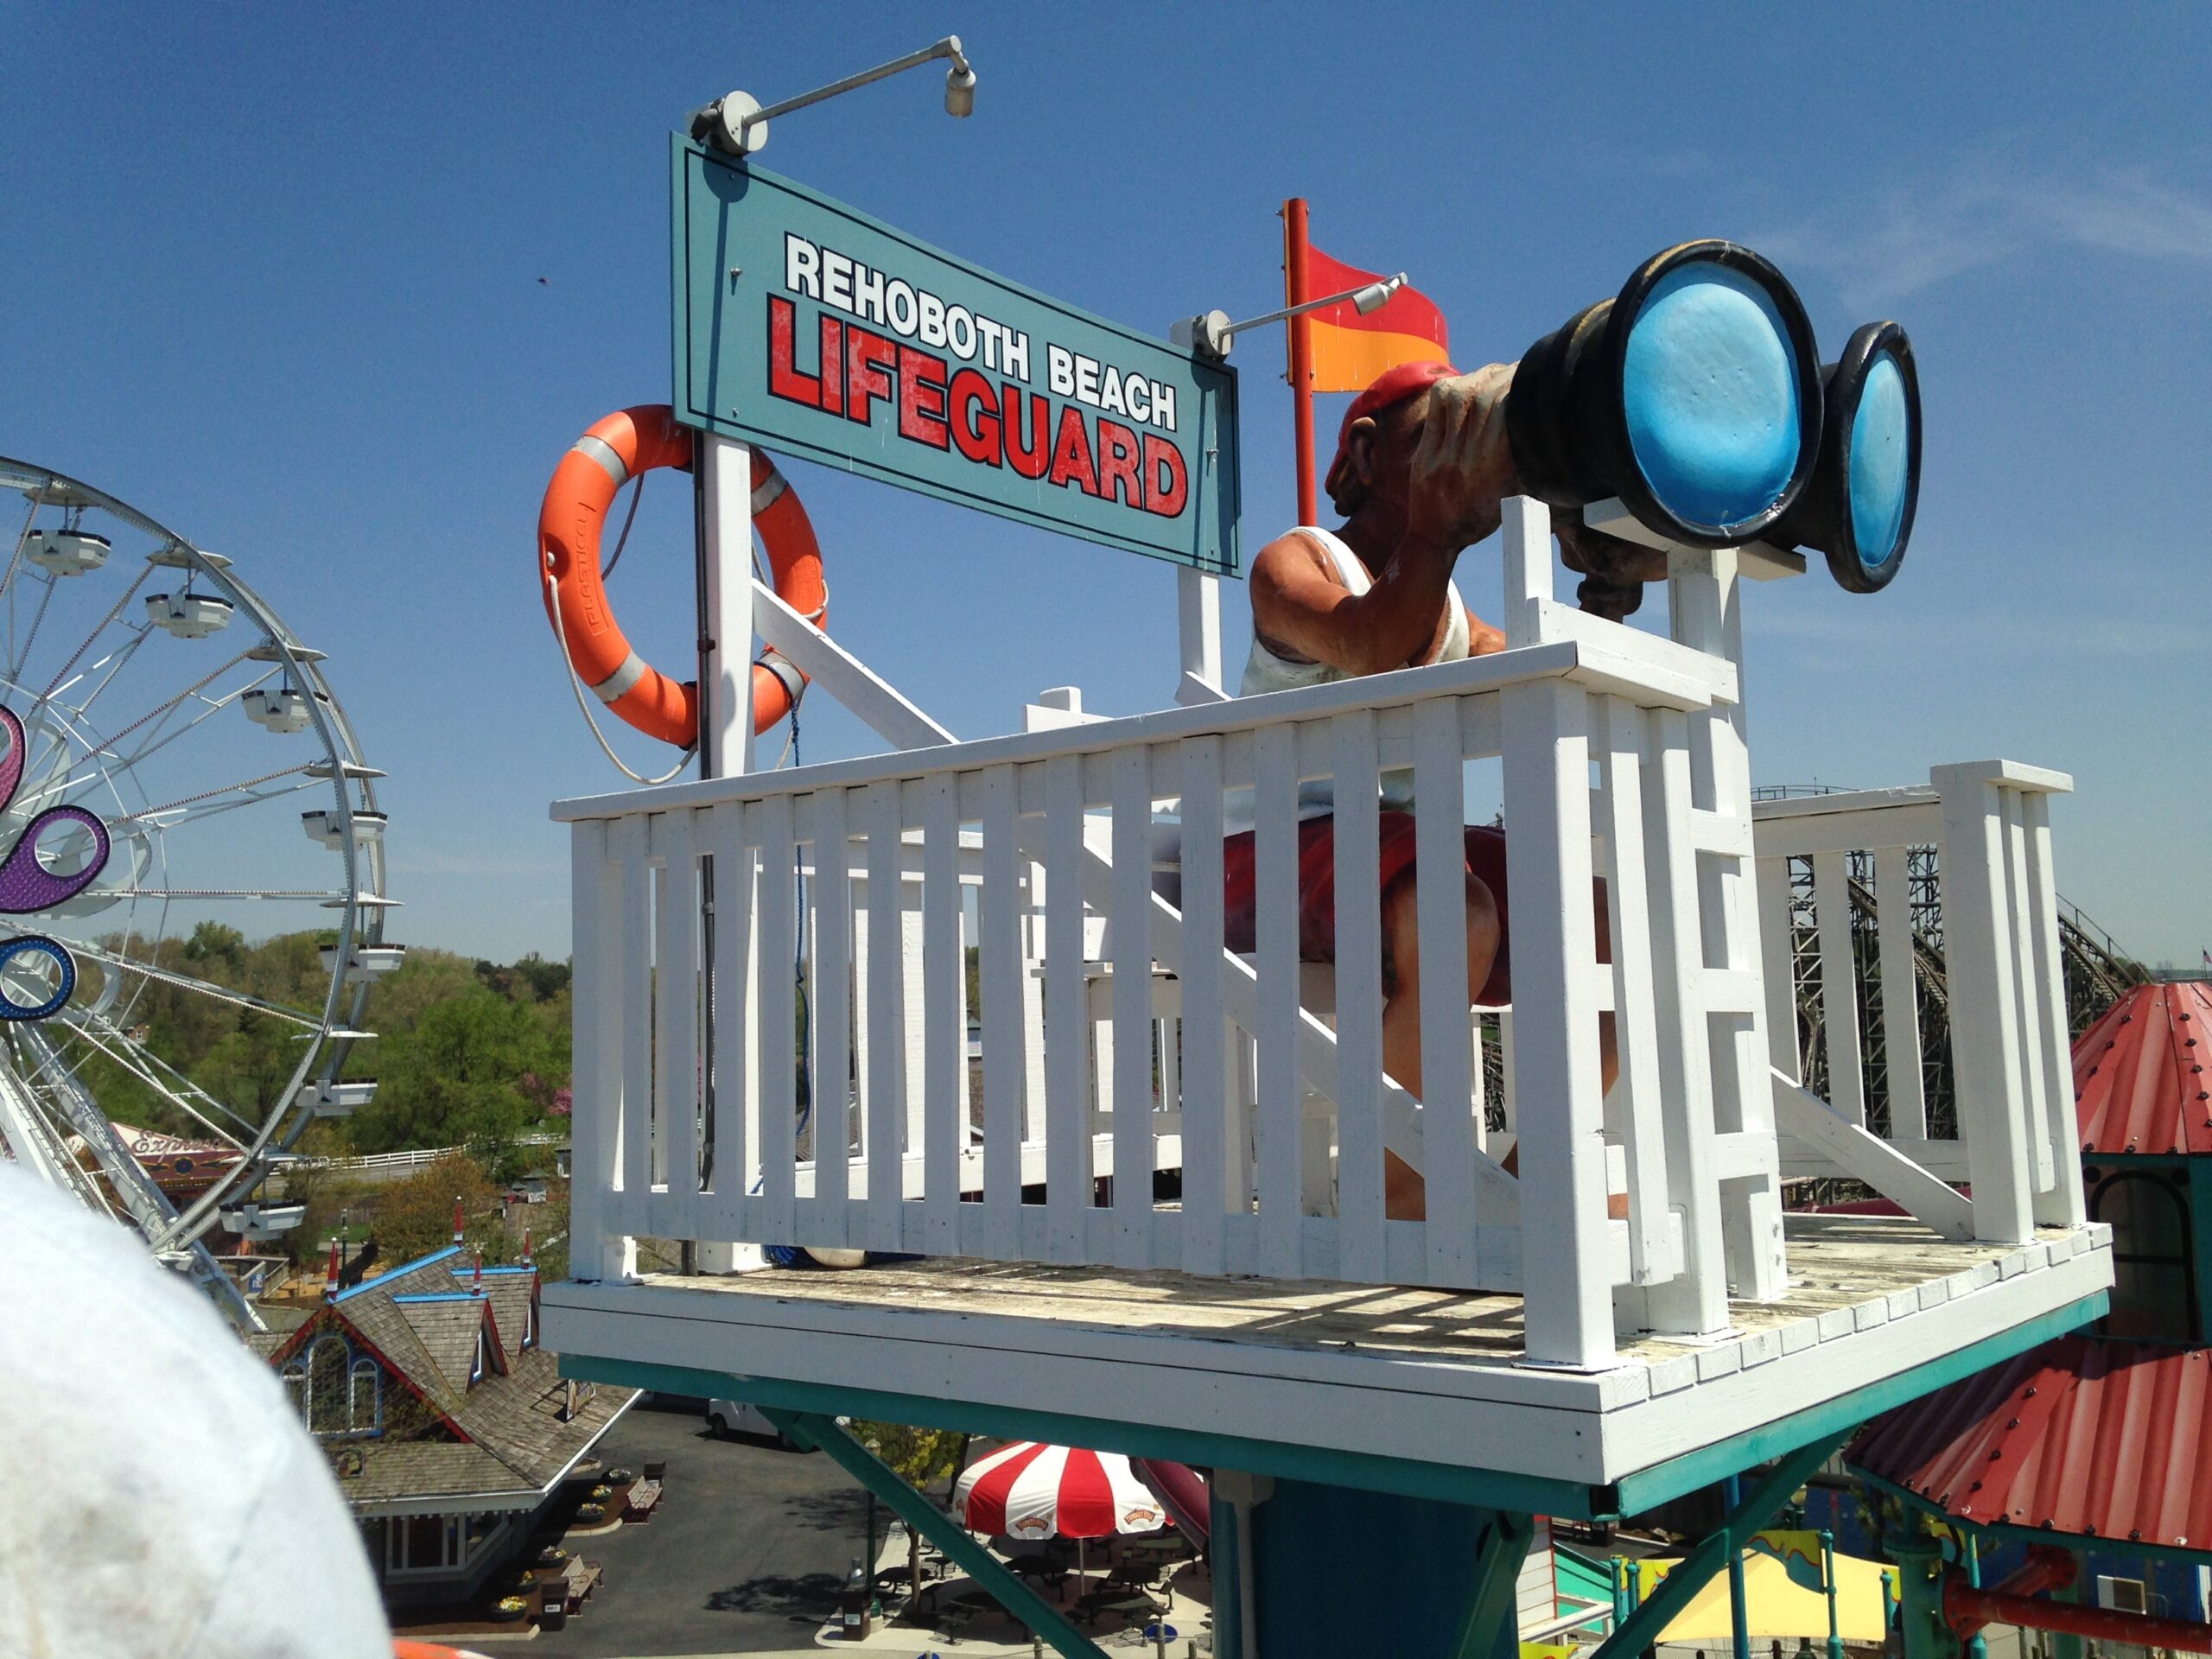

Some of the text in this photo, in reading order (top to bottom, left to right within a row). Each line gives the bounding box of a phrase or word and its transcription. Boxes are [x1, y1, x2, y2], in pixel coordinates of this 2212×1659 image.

[767, 293, 1188, 518] LIFEGUARD
[785, 232, 1177, 431] REHOBOTH BEACH
